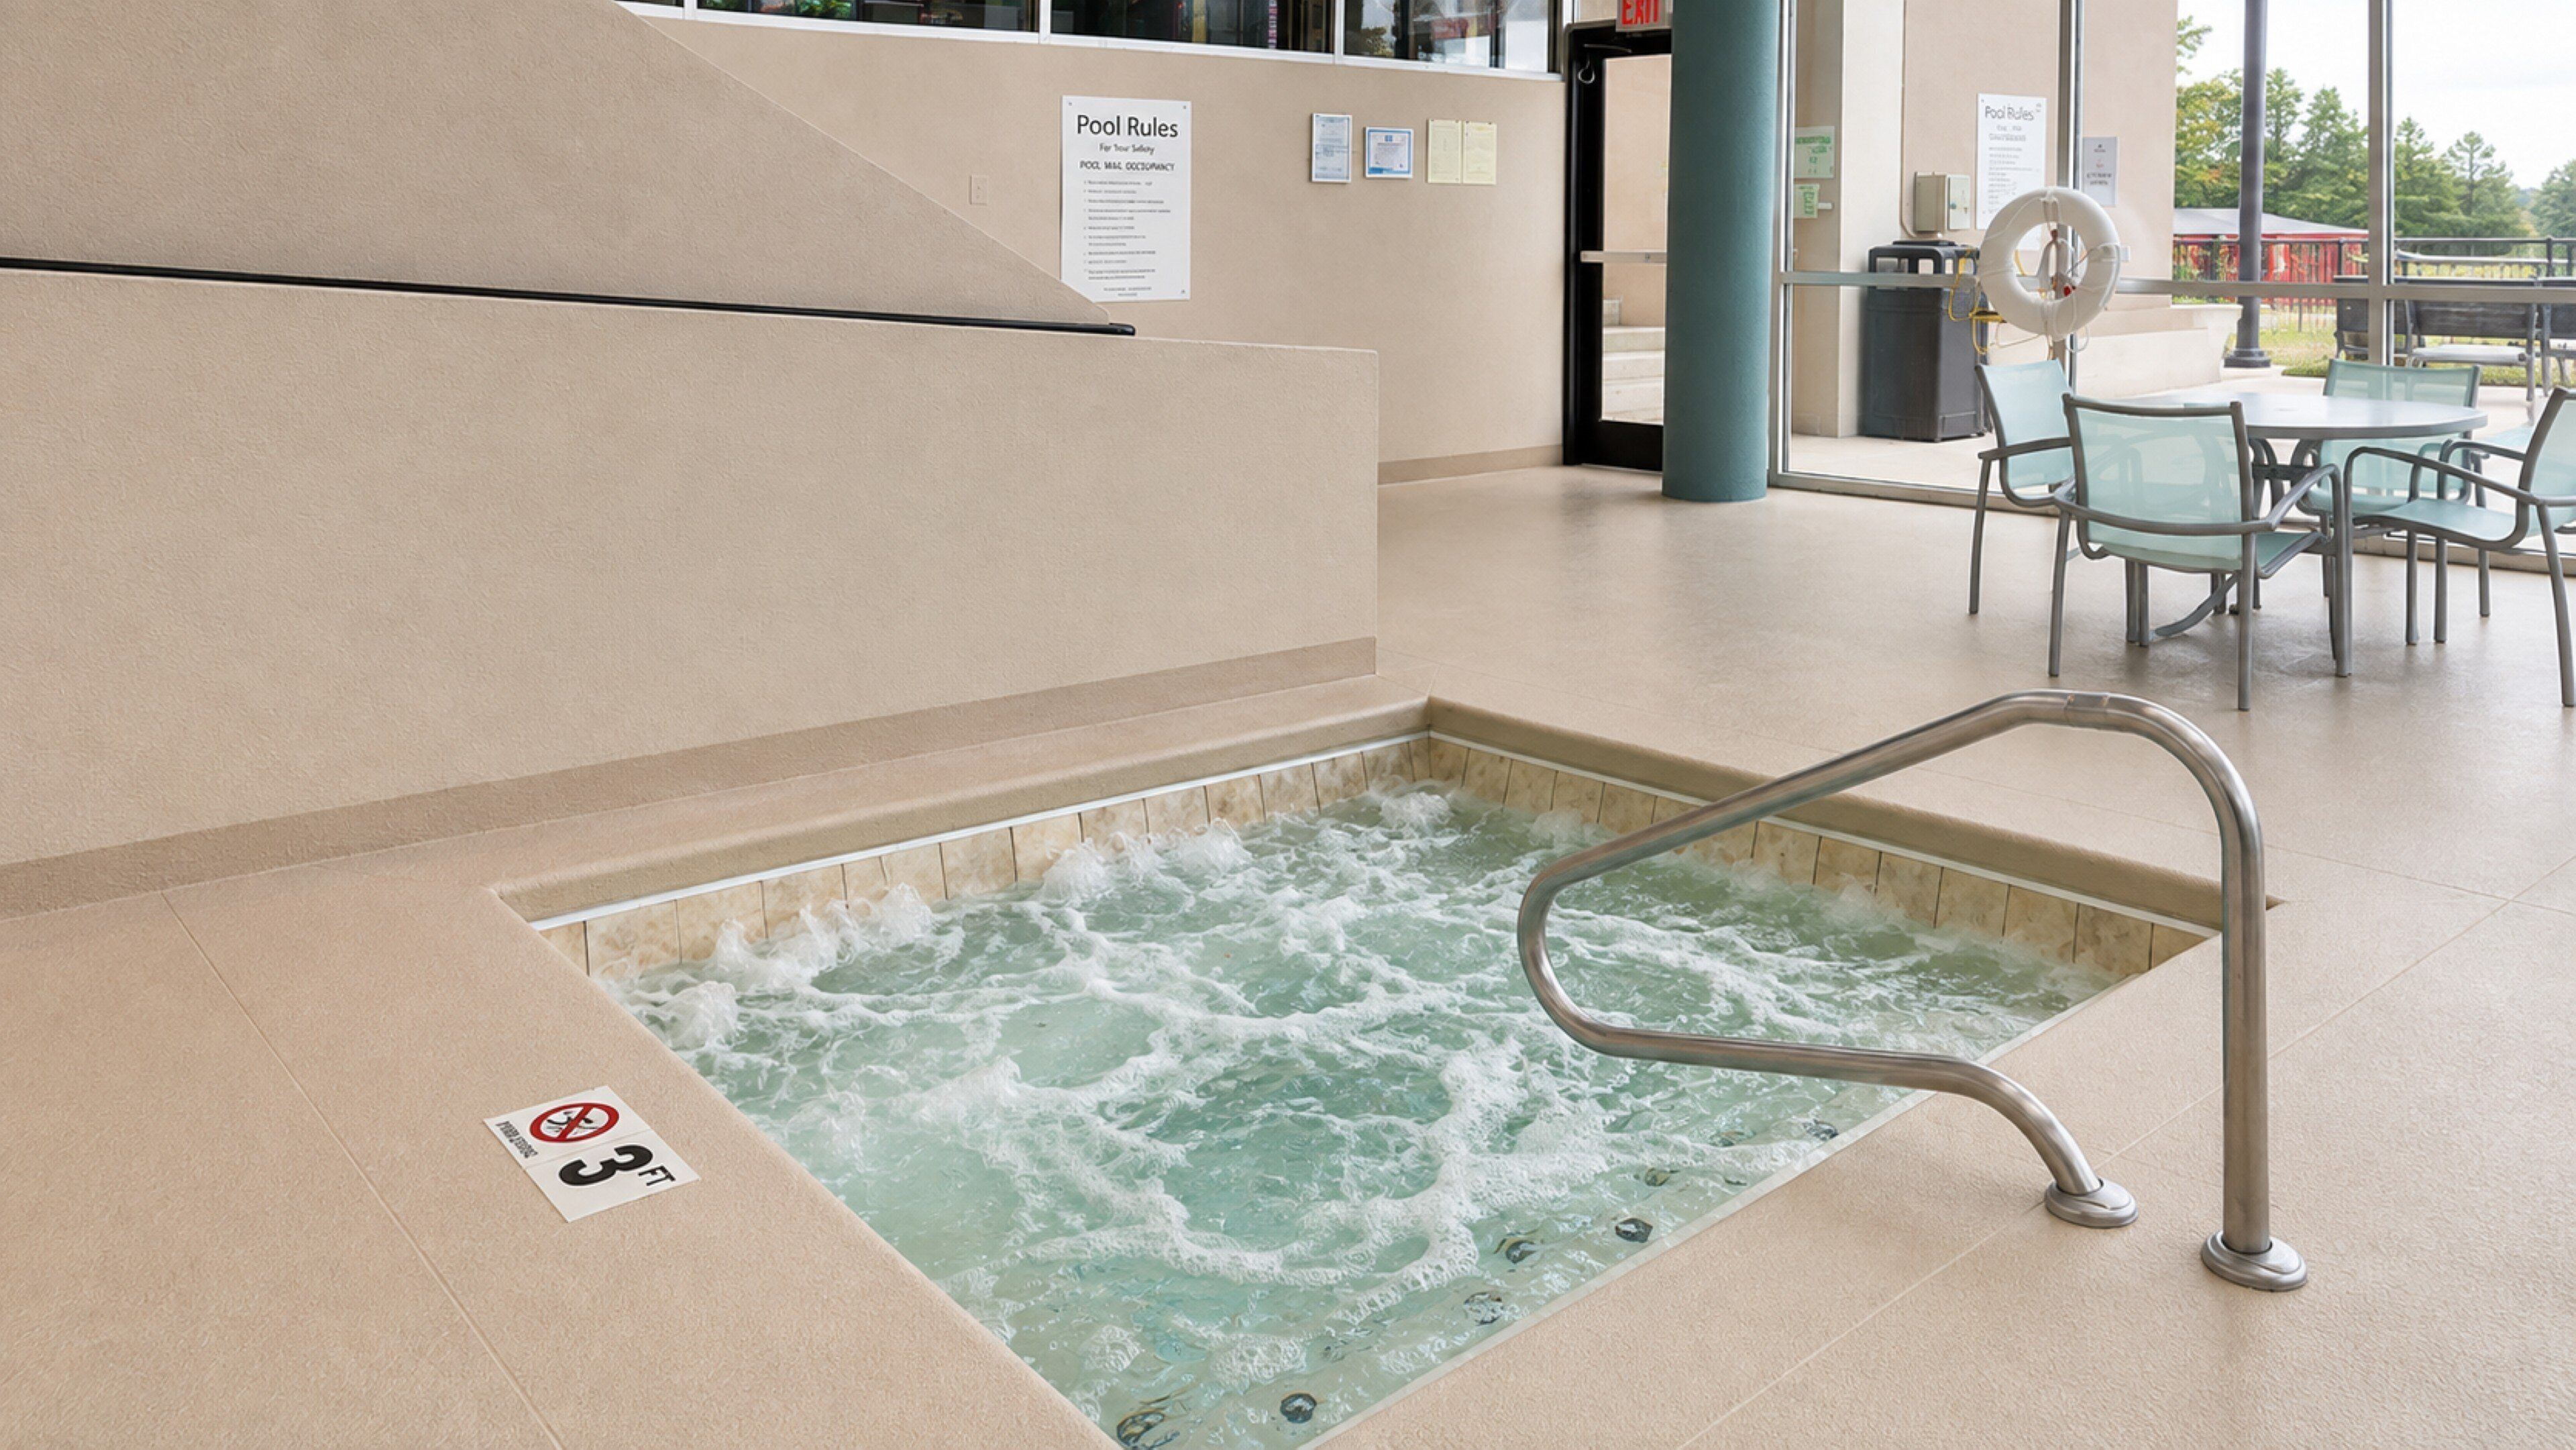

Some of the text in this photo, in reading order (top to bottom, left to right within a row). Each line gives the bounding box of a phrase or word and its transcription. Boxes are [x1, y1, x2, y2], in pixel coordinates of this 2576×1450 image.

[1622, 0, 1659, 25] EXIT
[1077, 115, 1179, 138] Pool Rules
[558, 1144, 676, 1186] 3 FT
